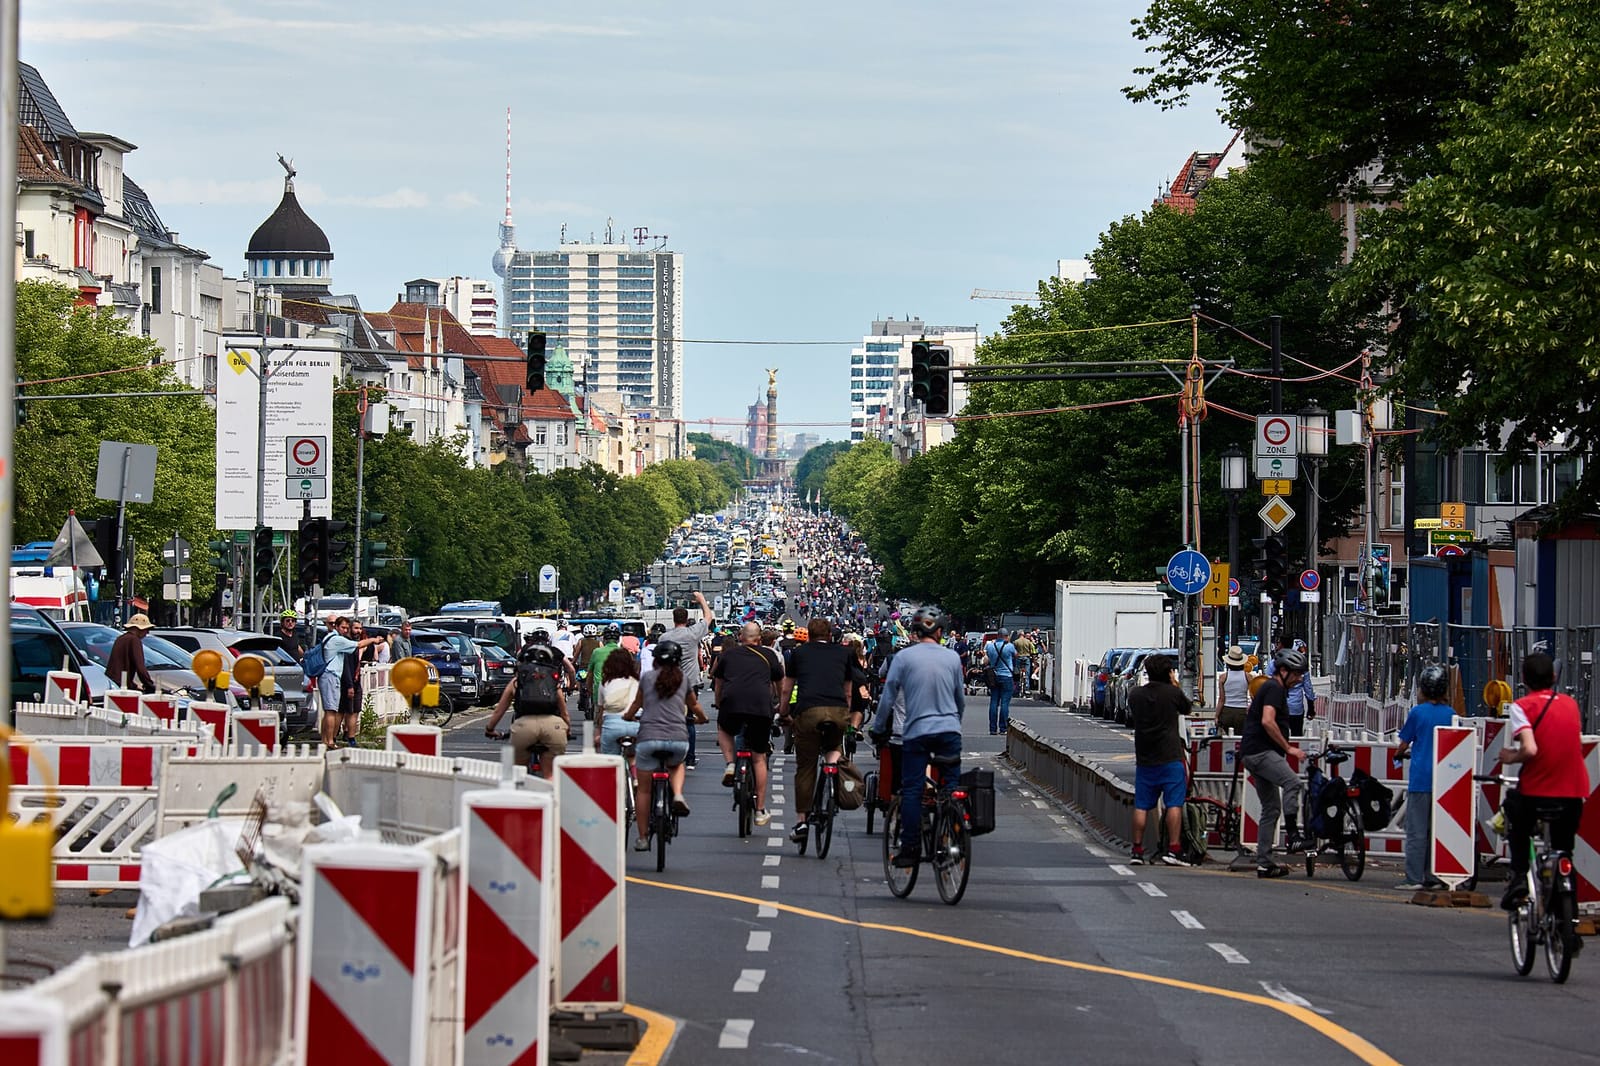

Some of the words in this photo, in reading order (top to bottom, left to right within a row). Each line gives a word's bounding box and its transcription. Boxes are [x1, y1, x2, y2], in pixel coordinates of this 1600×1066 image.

[296, 359, 308, 367] FÜR
[1266, 446, 1287, 454] ZONE
[296, 467, 317, 475] ZONE
[299, 490, 313, 498] frei
[1450, 506, 1456, 515] 2
[1212, 573, 1220, 584] U
